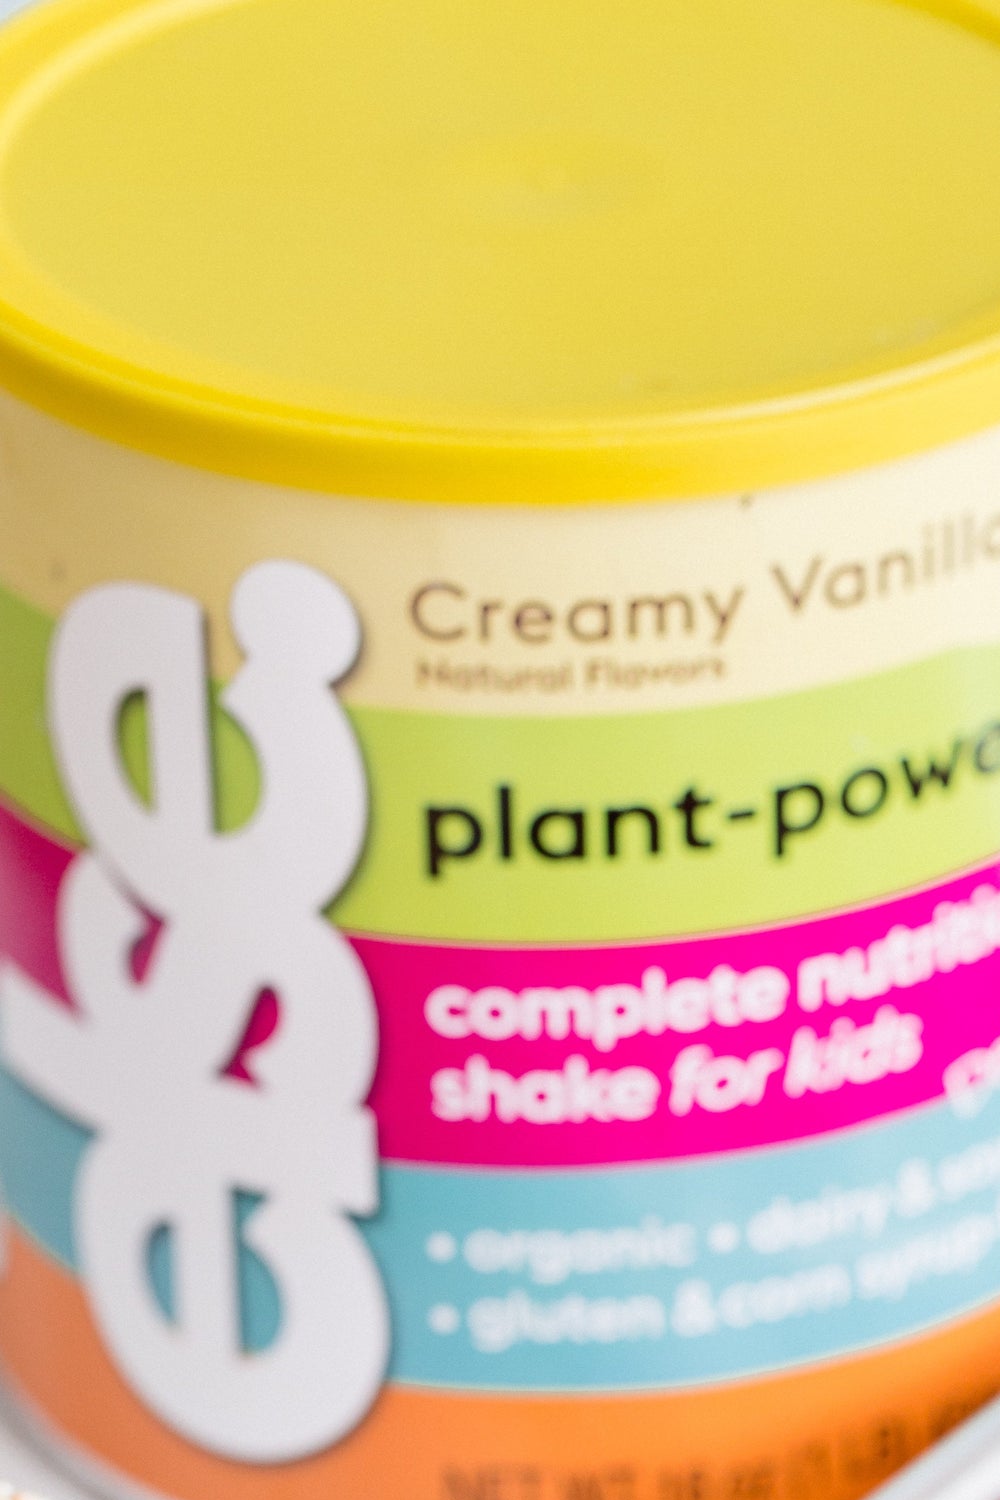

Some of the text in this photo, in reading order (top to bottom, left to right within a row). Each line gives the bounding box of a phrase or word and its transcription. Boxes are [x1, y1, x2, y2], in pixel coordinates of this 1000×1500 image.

[409, 579, 746, 648] Creamy
[415, 655, 727, 692] Natural Flavors
[424, 964, 790, 1052] complete
[430, 1004, 925, 1124] shake for kids
[463, 1216, 698, 1285] organic
[467, 1283, 666, 1352] gluten
